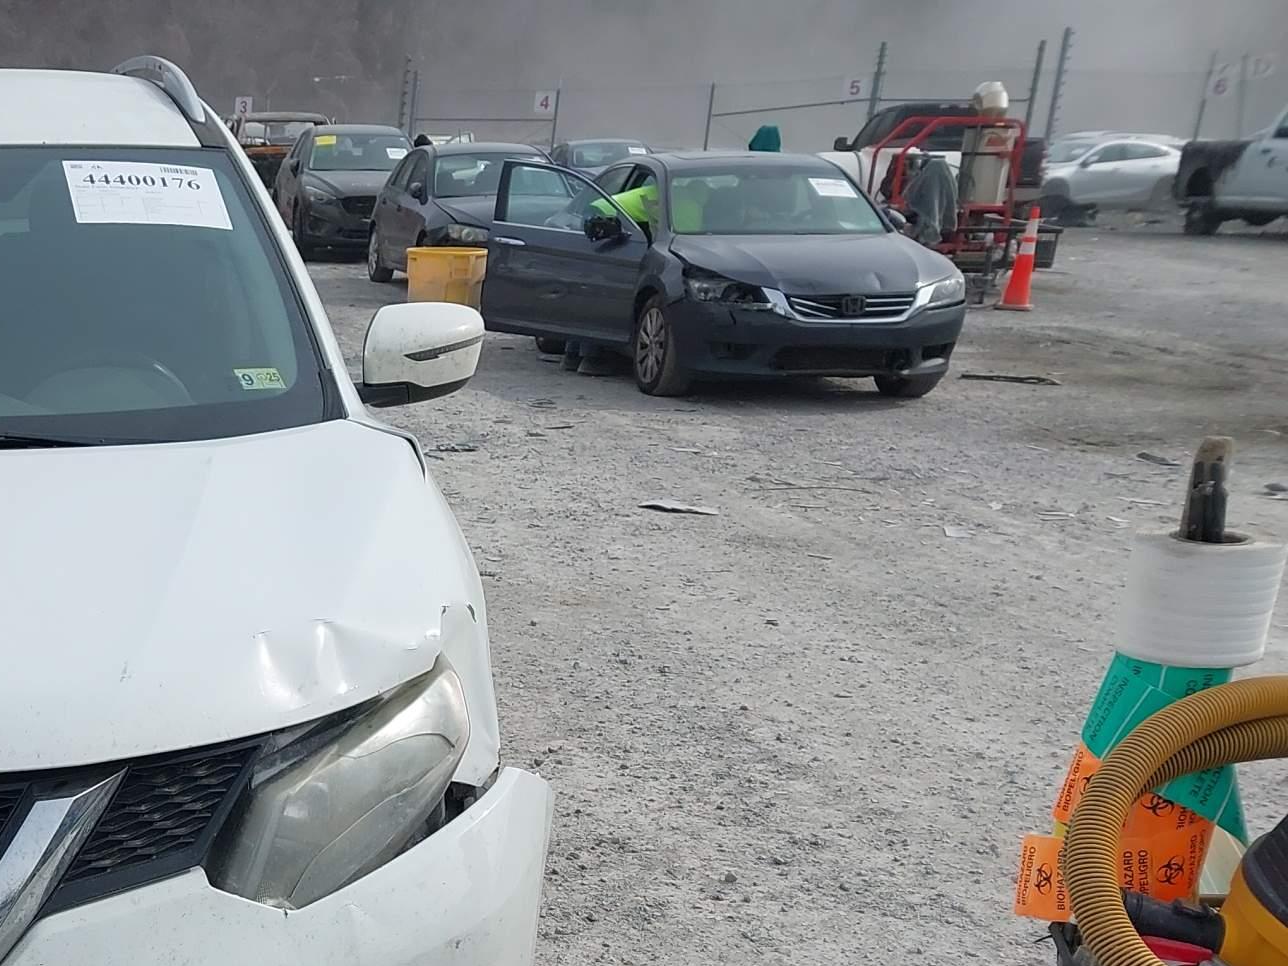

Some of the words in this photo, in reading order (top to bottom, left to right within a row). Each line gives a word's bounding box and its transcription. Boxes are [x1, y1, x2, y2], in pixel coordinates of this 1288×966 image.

[849, 79, 861, 96] 5
[239, 100, 248, 113] 3
[539, 95, 550, 111] 4
[82, 173, 201, 191] 44400176
[241, 373, 254, 386] 9
[265, 371, 281, 383] 25
[1021, 846, 1037, 906] BIOPELIGRO
